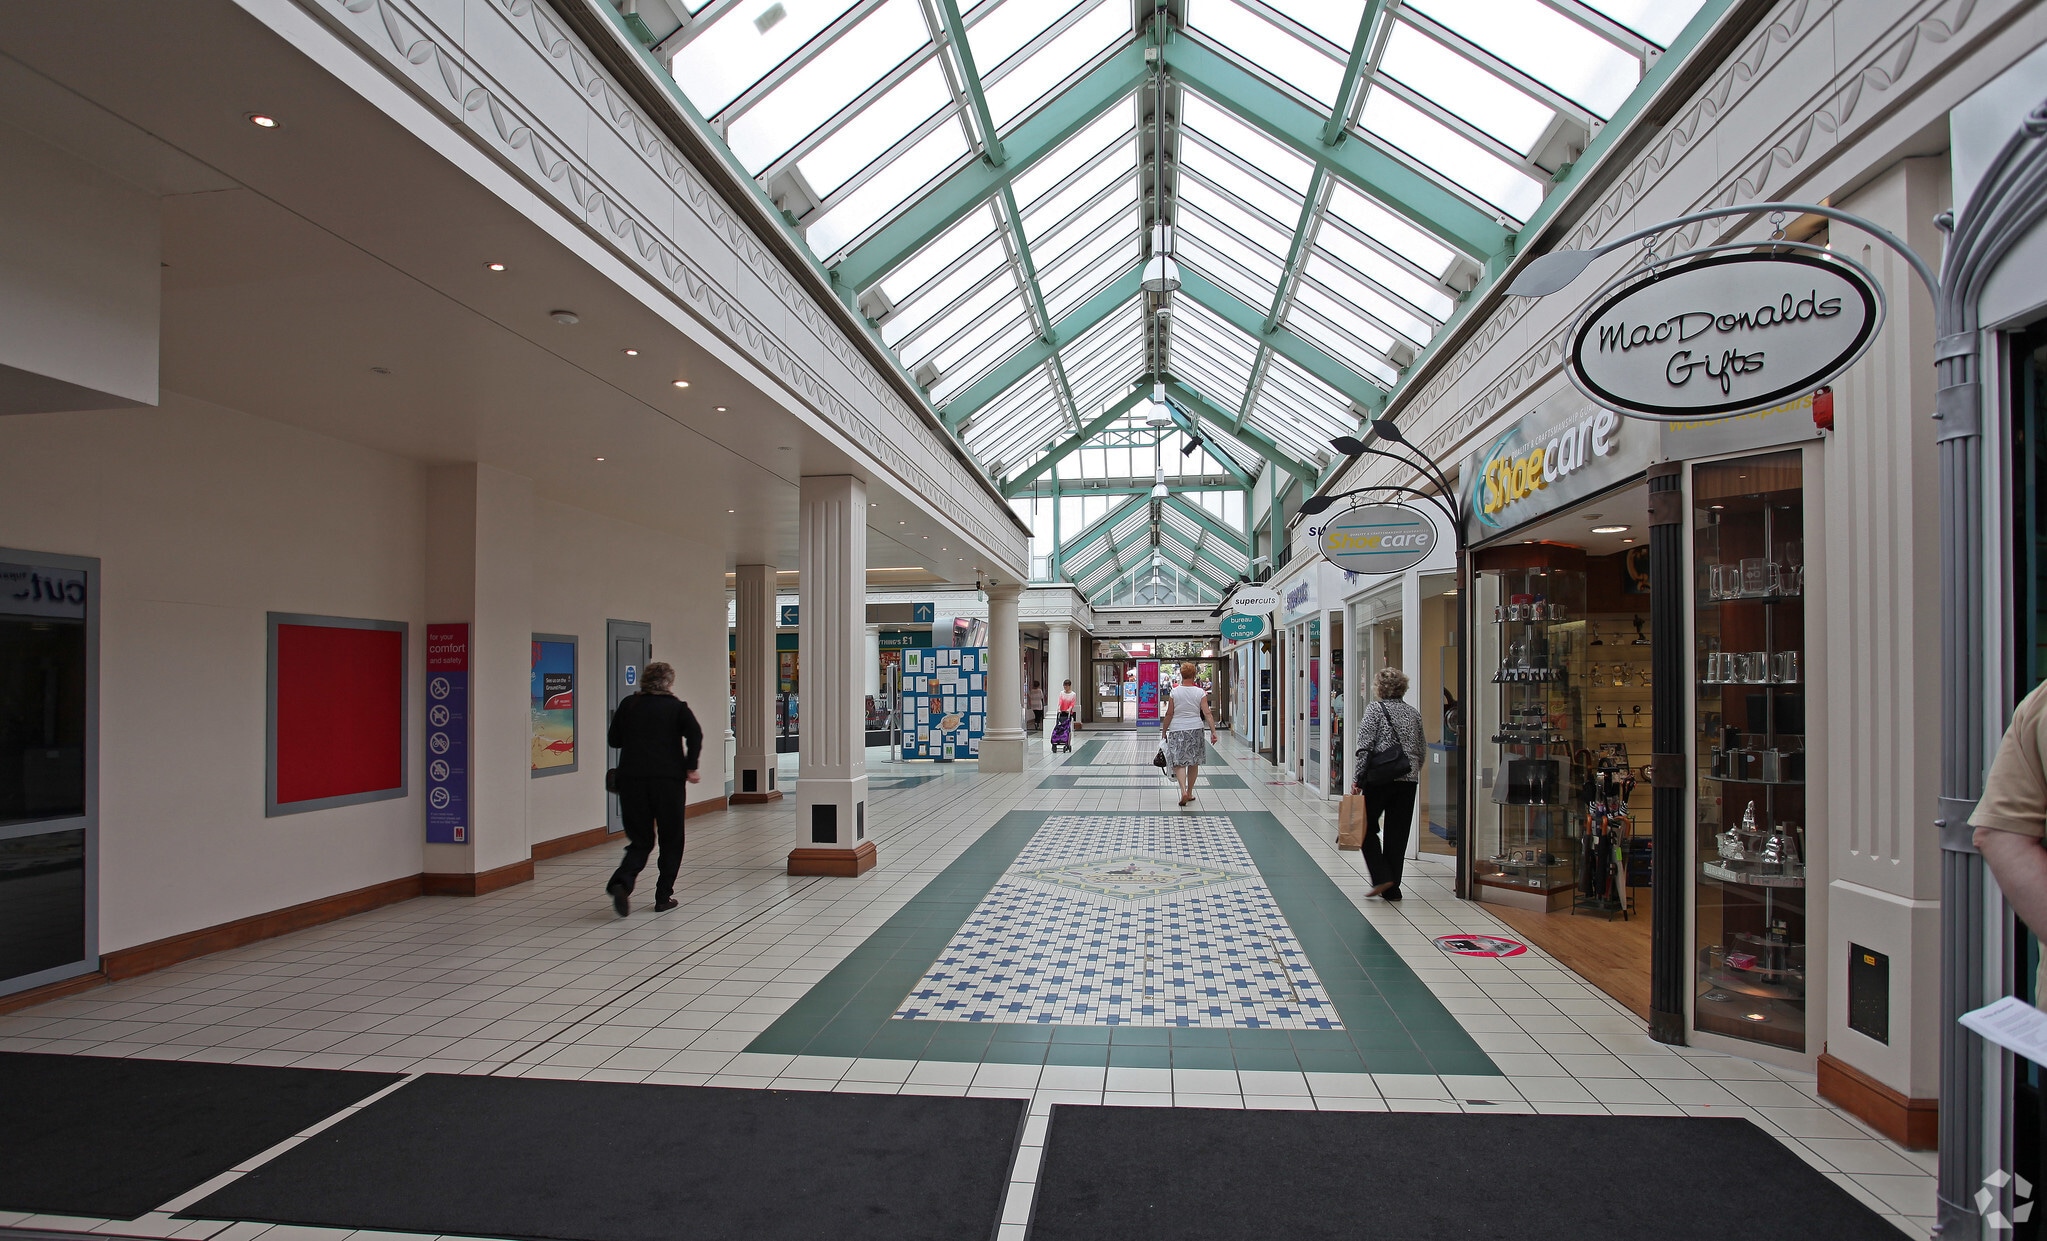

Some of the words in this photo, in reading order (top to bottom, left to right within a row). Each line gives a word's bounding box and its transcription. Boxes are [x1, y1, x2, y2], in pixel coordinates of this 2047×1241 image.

[1599, 289, 1842, 353] MacDonalds
[1666, 348, 1765, 396] Gifts
[1734, 395, 1813, 420] pairs
[1484, 408, 1615, 514] Shoecare
[1327, 533, 1429, 550] Shoecare
[1235, 597, 1276, 606] supercuts
[902, 636, 913, 645] £1
[430, 644, 465, 653] comfort
[443, 657, 462, 665] safety
[909, 654, 918, 665] M
